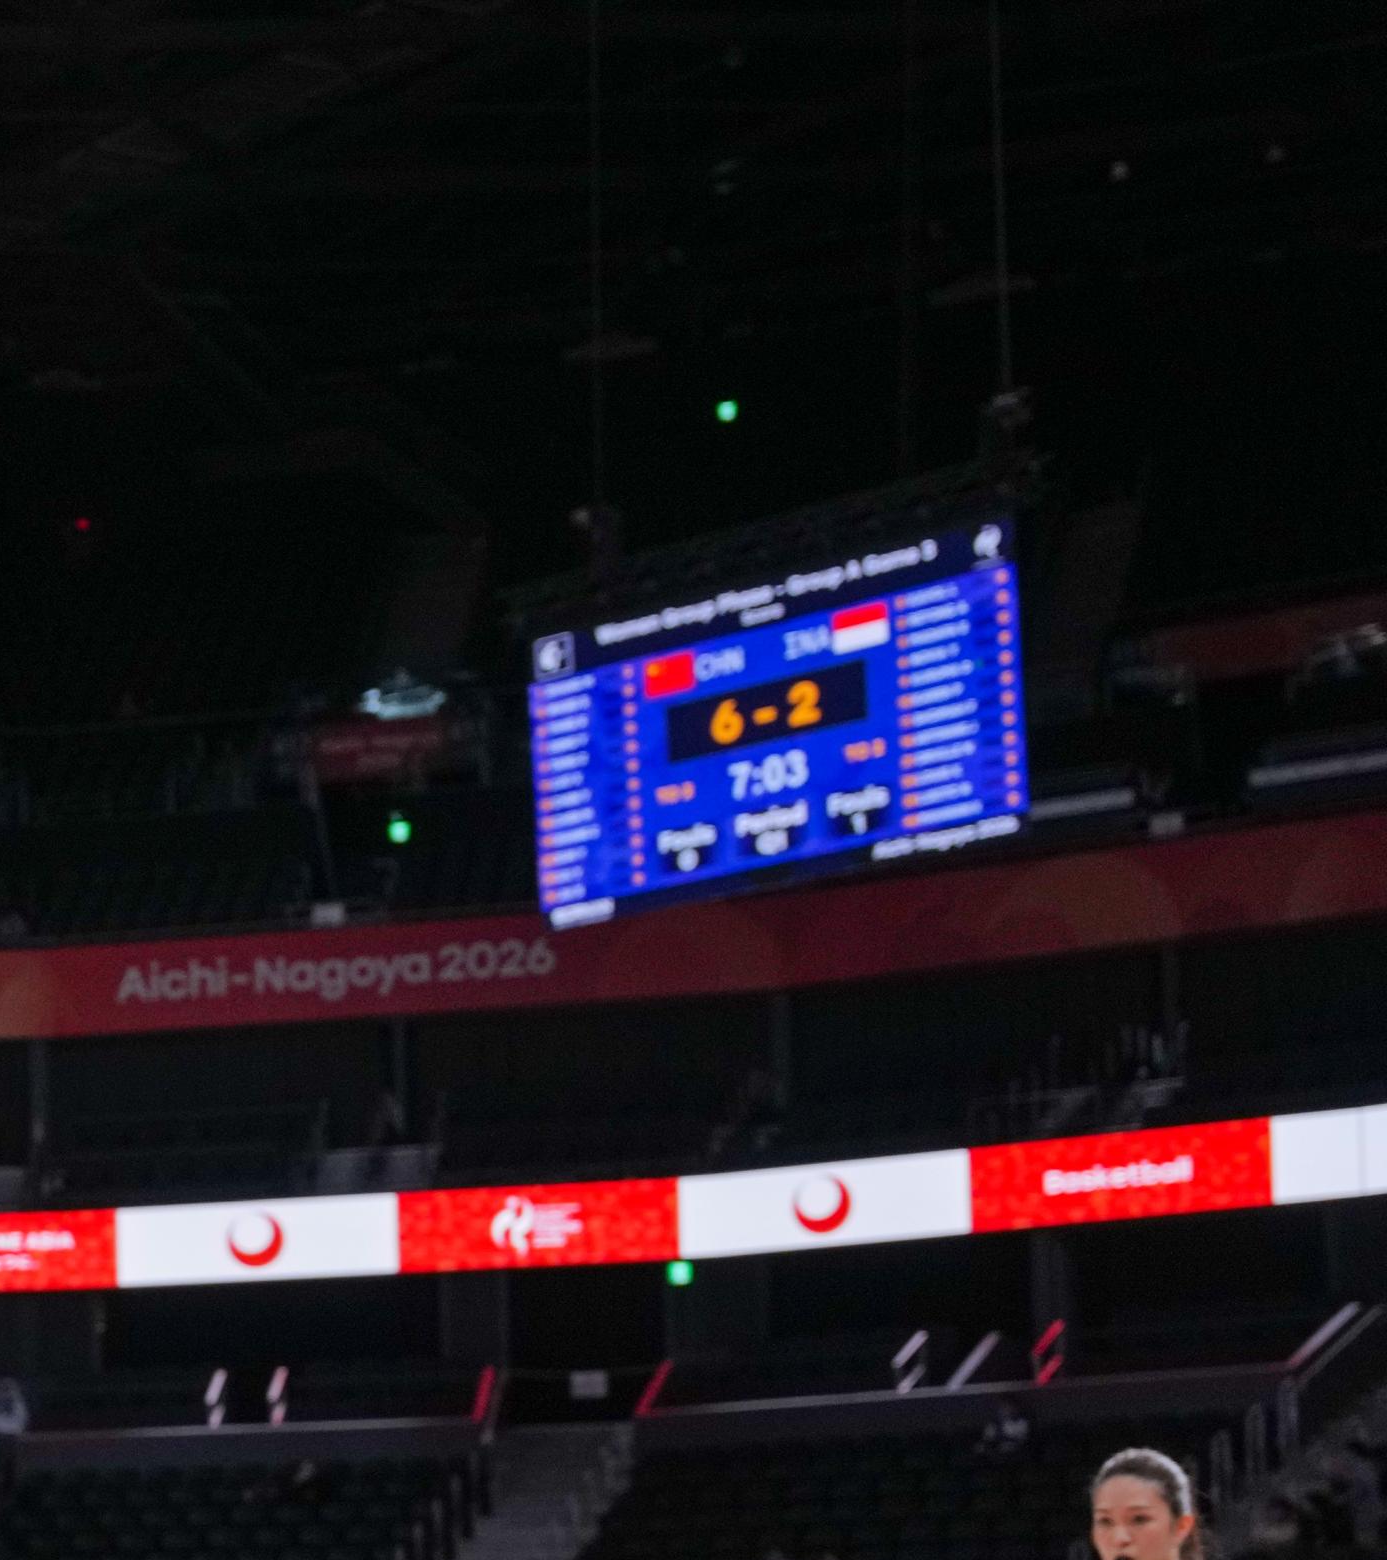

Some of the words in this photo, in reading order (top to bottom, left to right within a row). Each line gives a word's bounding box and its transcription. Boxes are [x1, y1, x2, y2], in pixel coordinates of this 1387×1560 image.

[695, 645, 745, 682] CHN
[783, 625, 832, 661] INA
[710, 698, 744, 745] 6
[752, 705, 778, 725] -
[787, 680, 822, 728] 2
[728, 749, 809, 801] 7:03
[734, 799, 809, 838] Period
[117, 951, 431, 1002] Aichi-Nagoya
[438, 937, 556, 982] 2026
[1043, 1154, 1194, 1196] Basketball
